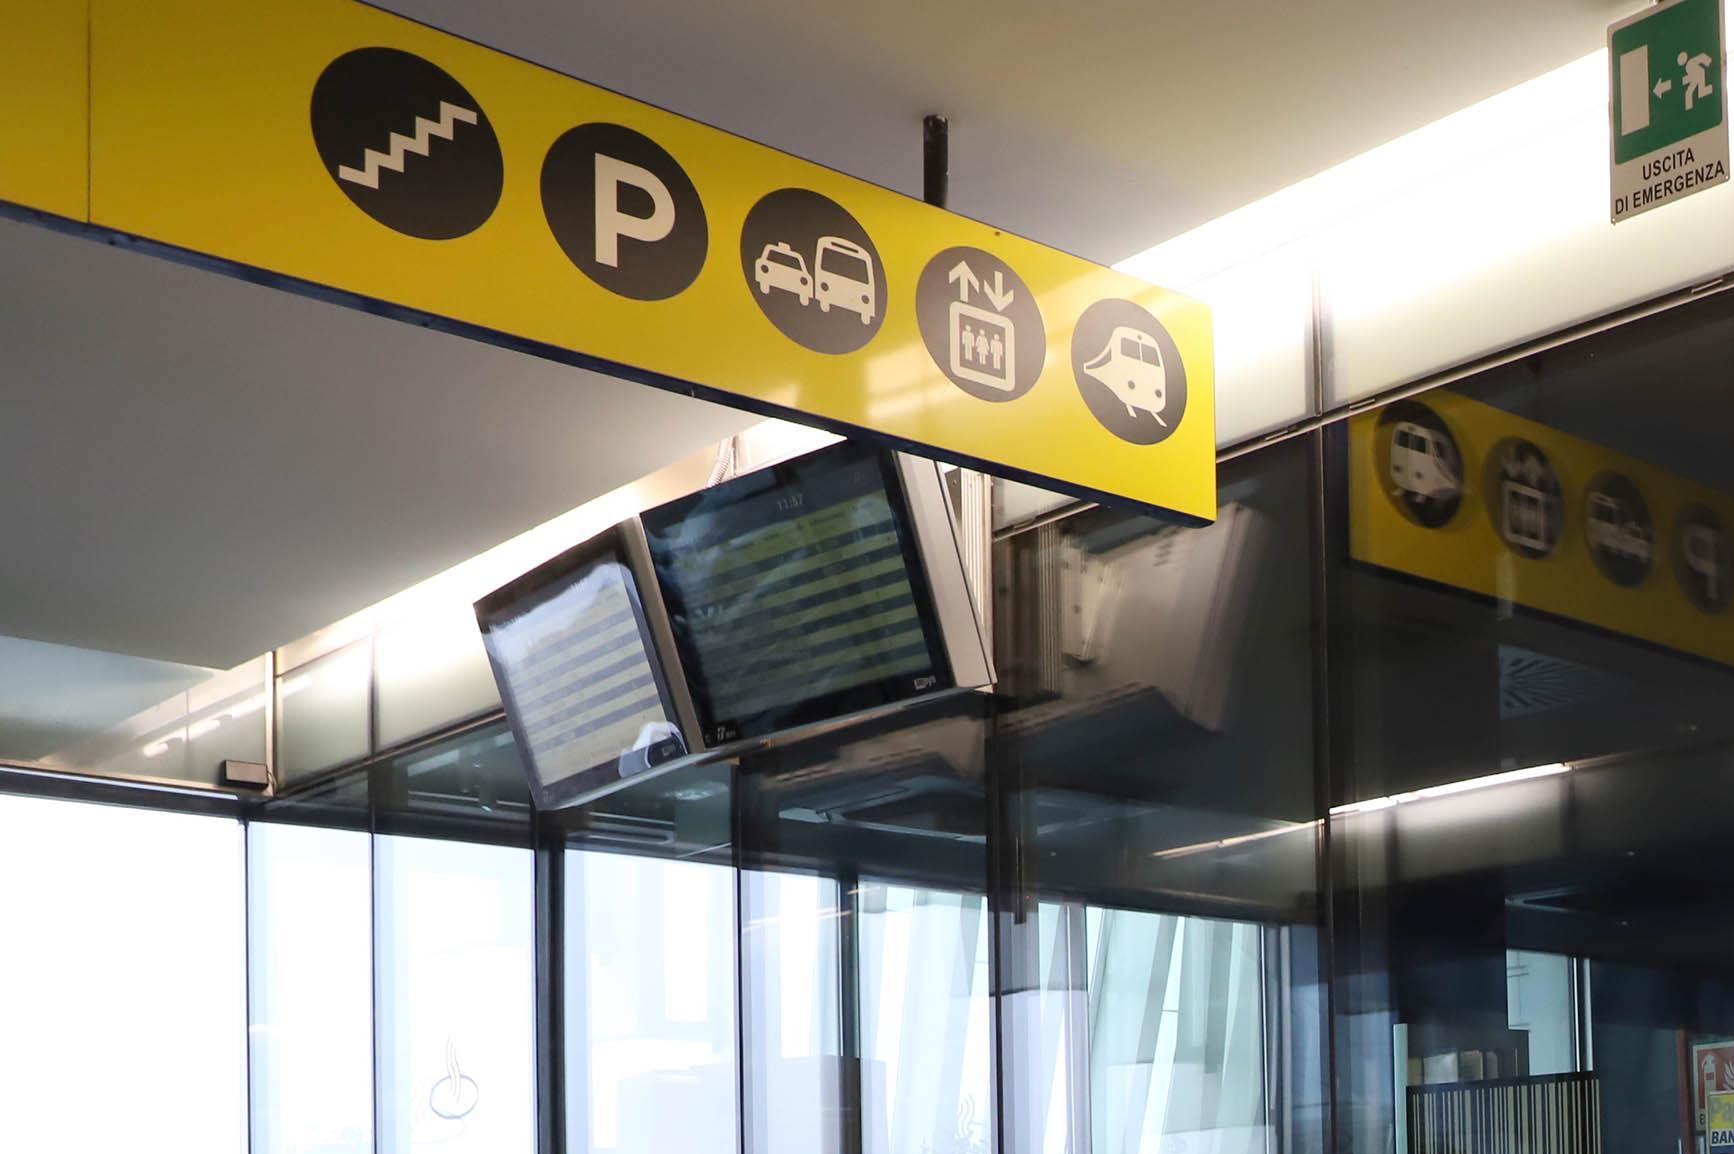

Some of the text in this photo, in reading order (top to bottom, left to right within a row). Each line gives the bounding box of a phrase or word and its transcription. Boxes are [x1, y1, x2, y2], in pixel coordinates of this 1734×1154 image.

[1615, 160, 1725, 215] DI EMERGENZA
[1642, 148, 1695, 180] USCITA
[593, 152, 677, 269] P
